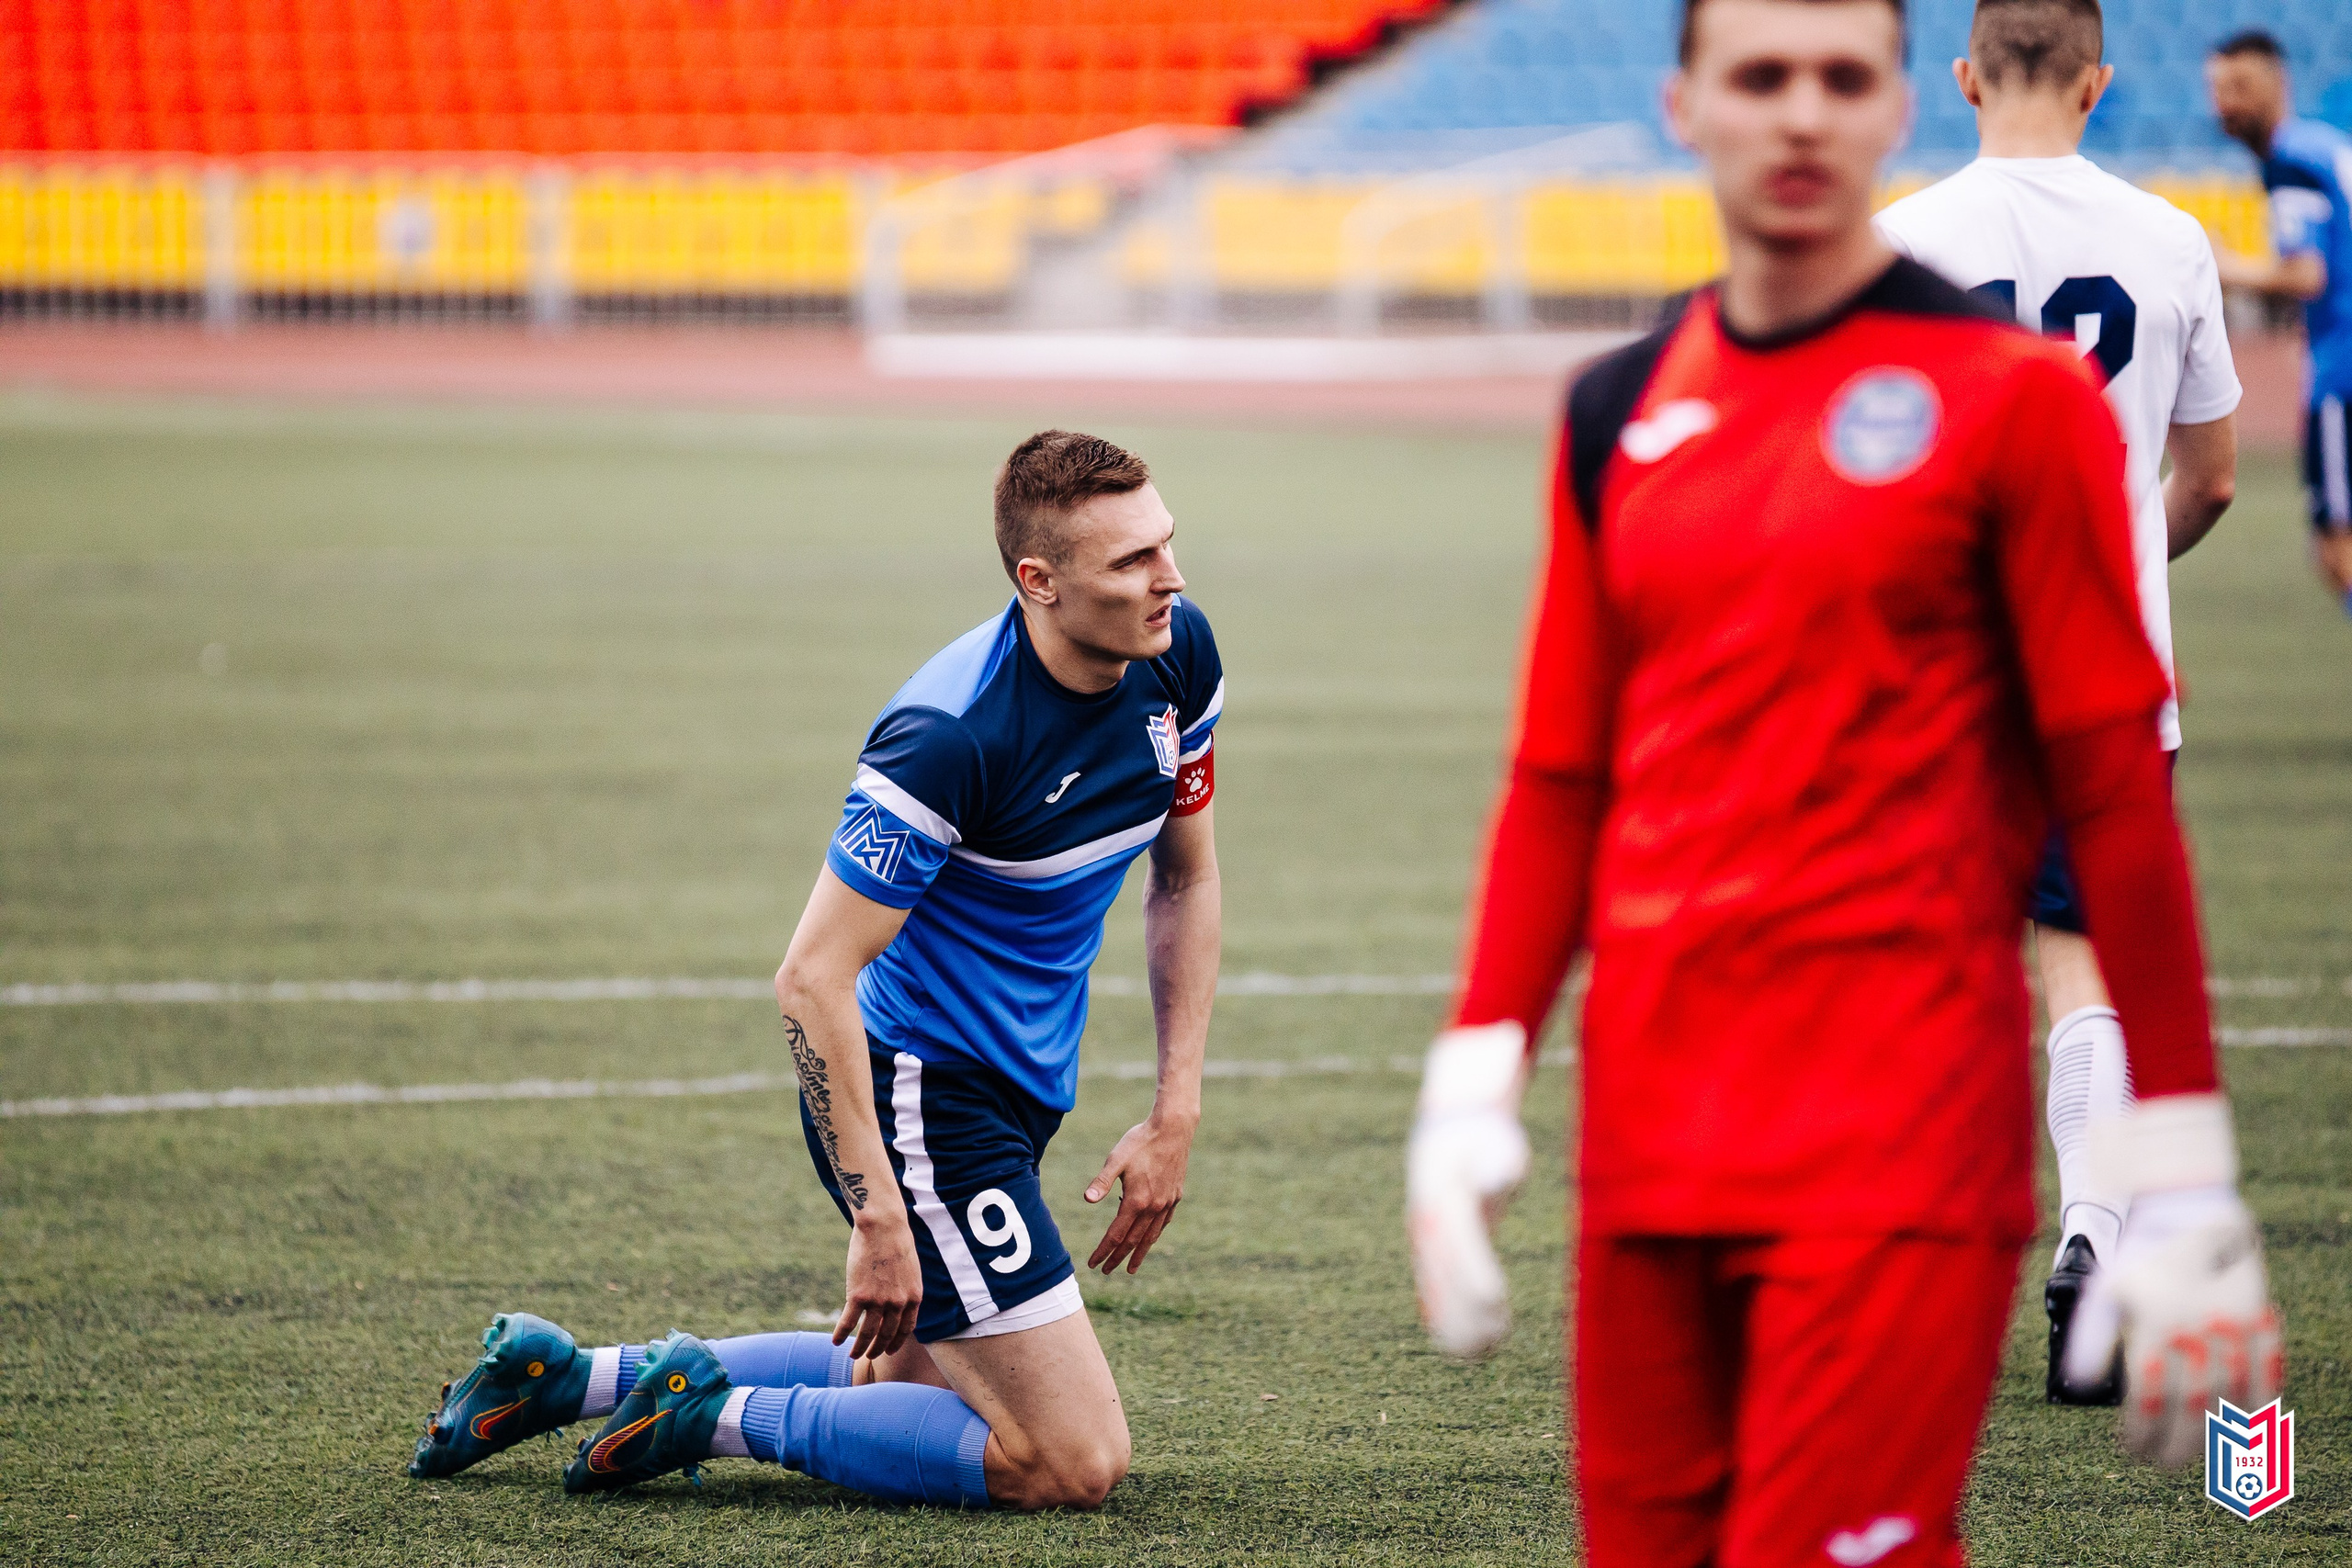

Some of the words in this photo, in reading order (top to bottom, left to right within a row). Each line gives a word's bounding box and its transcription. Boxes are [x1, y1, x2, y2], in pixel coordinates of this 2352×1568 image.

[1966, 275, 2136, 391] 2
[1176, 783, 1210, 806] KELME
[967, 1188, 1032, 1274] 9
